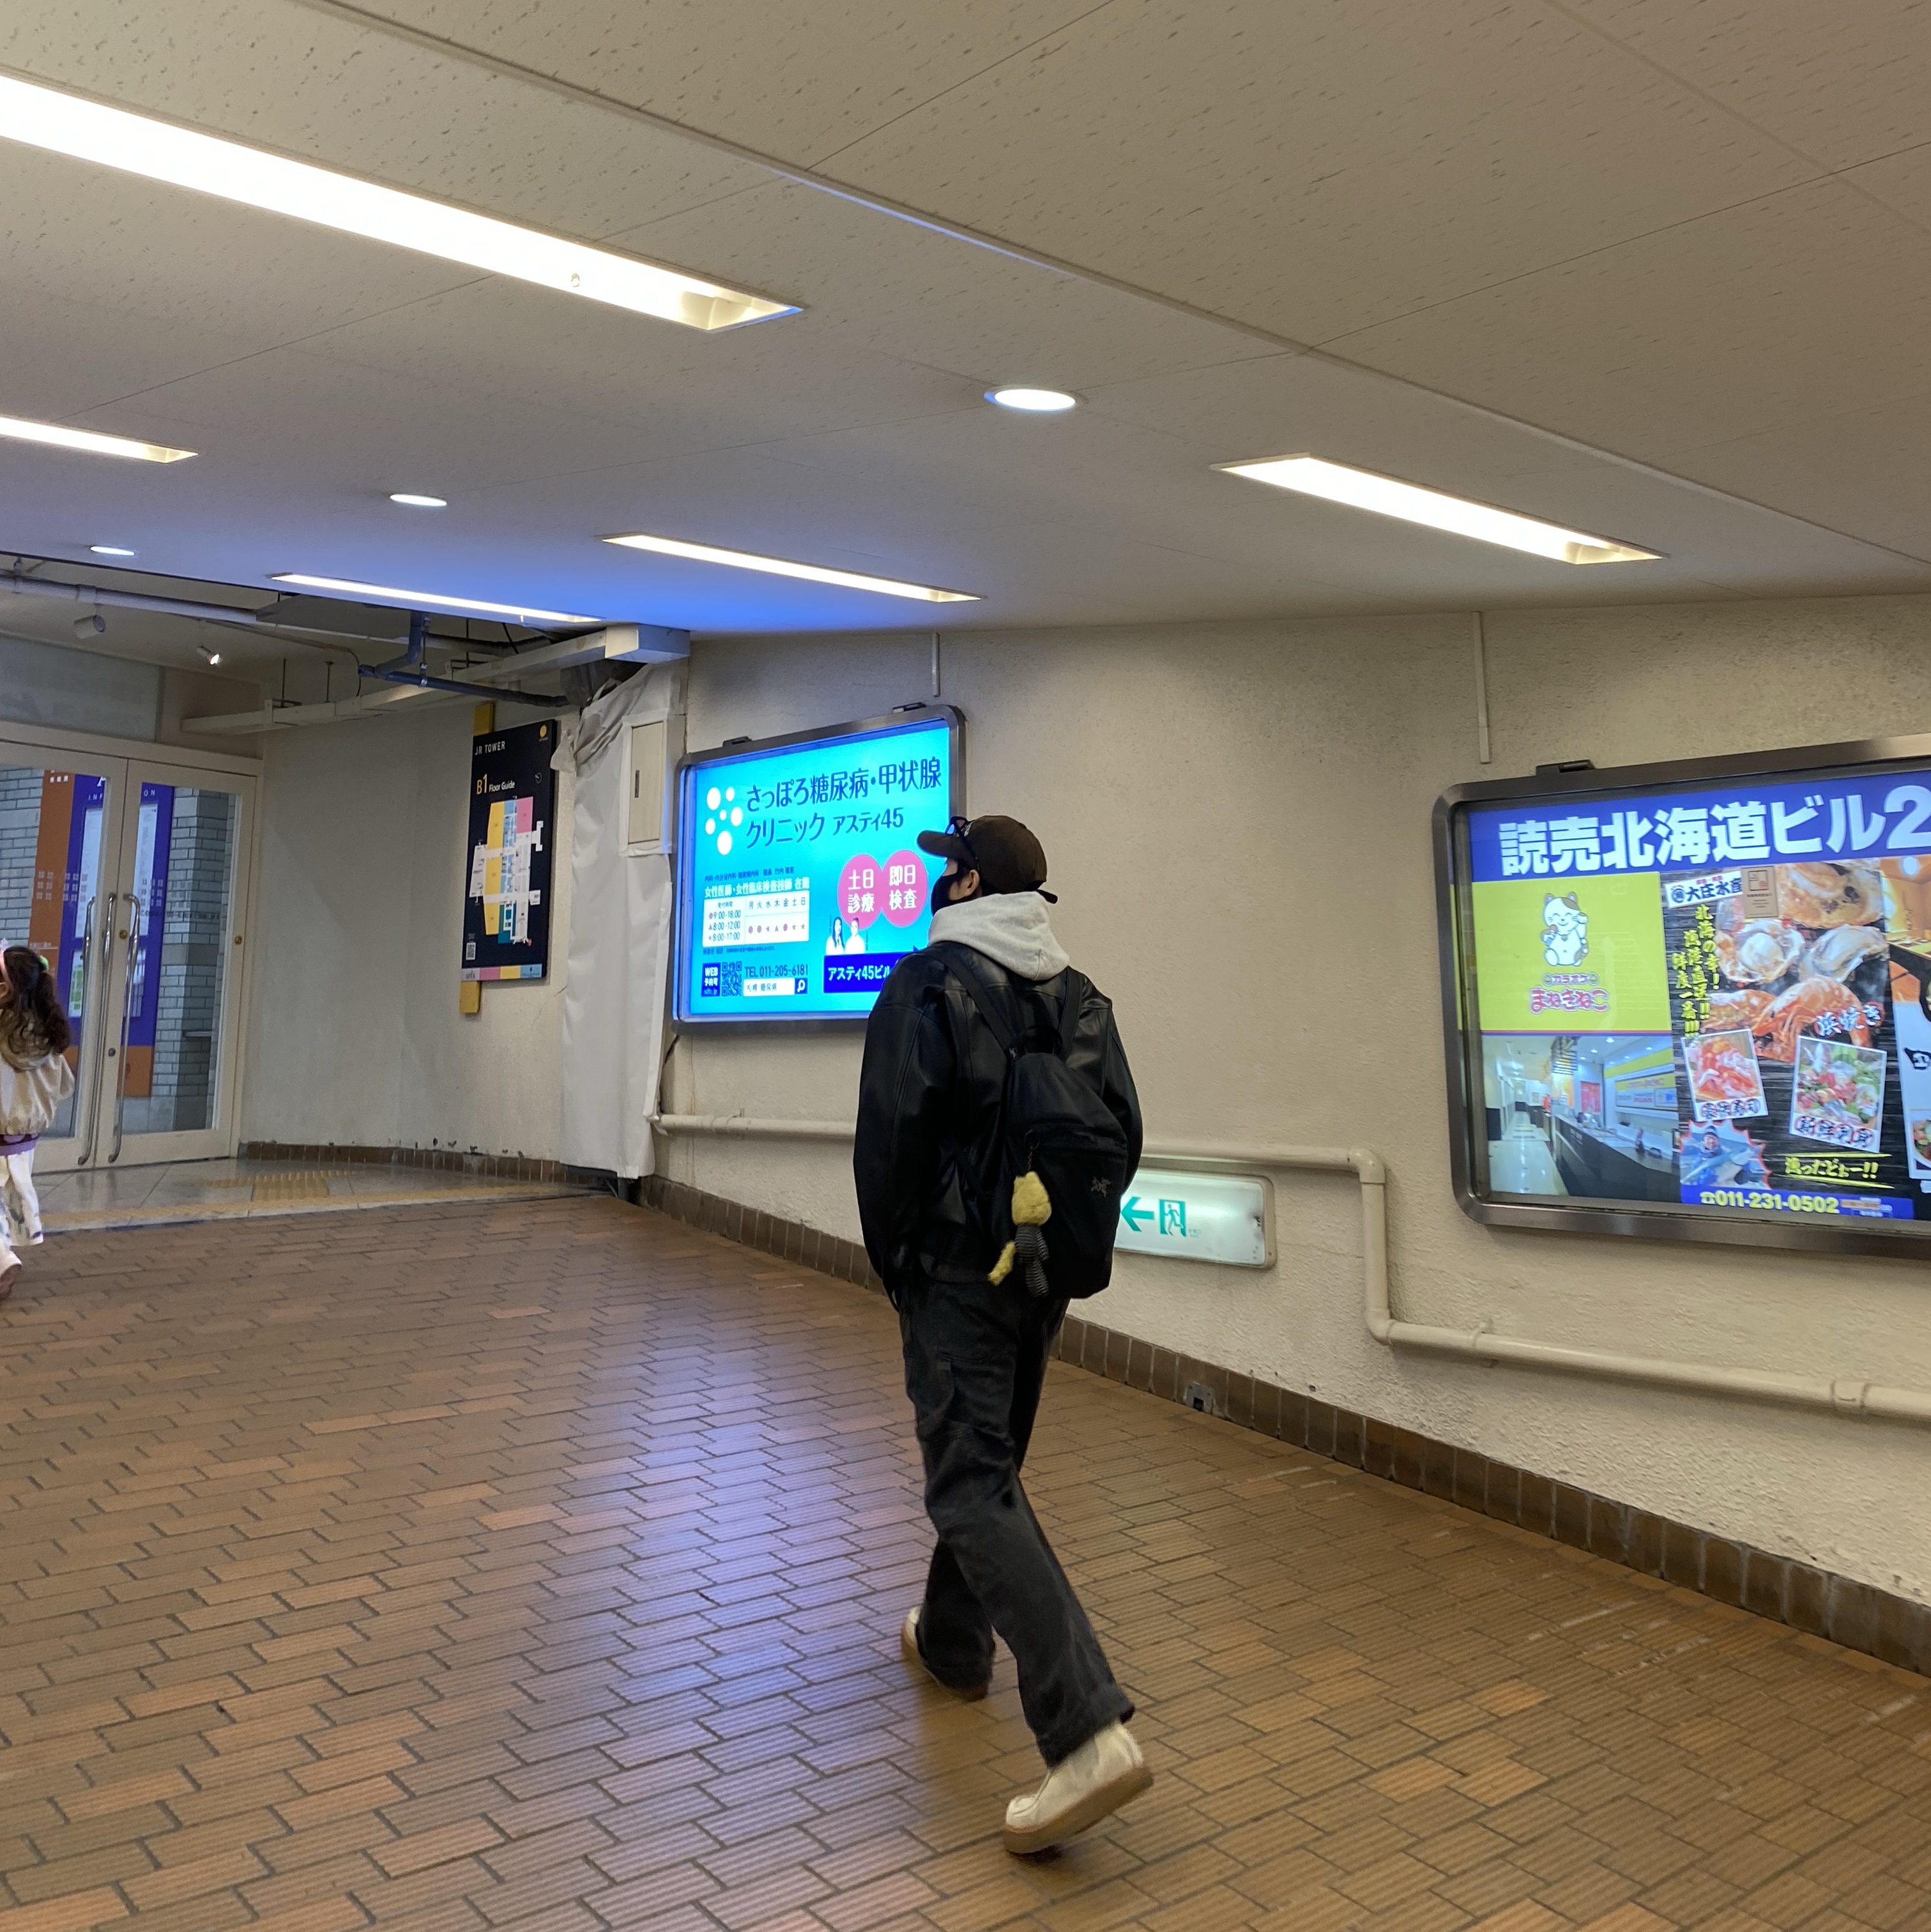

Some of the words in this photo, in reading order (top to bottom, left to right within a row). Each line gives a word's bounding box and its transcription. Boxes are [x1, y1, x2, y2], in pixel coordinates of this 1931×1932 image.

[475, 746, 482, 755] JR
[485, 741, 505, 753] TOWER
[477, 774, 487, 795] B1
[489, 784, 501, 792] Floor
[501, 780, 515, 790] Guide
[747, 756, 942, 812] さっぽろ糖尿病・甲状腺
[746, 812, 825, 849] クリニック
[832, 807, 904, 836] アスティ45
[848, 869, 874, 890] 土日
[889, 864, 916, 886] 即日
[749, 901, 753, 909] 月
[757, 900, 762, 908] 火
[774, 899, 780, 907] 木
[784, 898, 789, 907] 金
[792, 898, 797, 906] 土
[801, 897, 805, 905] 日
[847, 892, 874, 914] 診療
[889, 889, 917, 910] 検査
[705, 967, 718, 977] WEB
[744, 966, 758, 977] TEL
[759, 963, 809, 977] 011-205-6181
[1529, 985, 1610, 1015] まねきねこ
[1714, 1190, 1840, 1214] 011-231-0502
